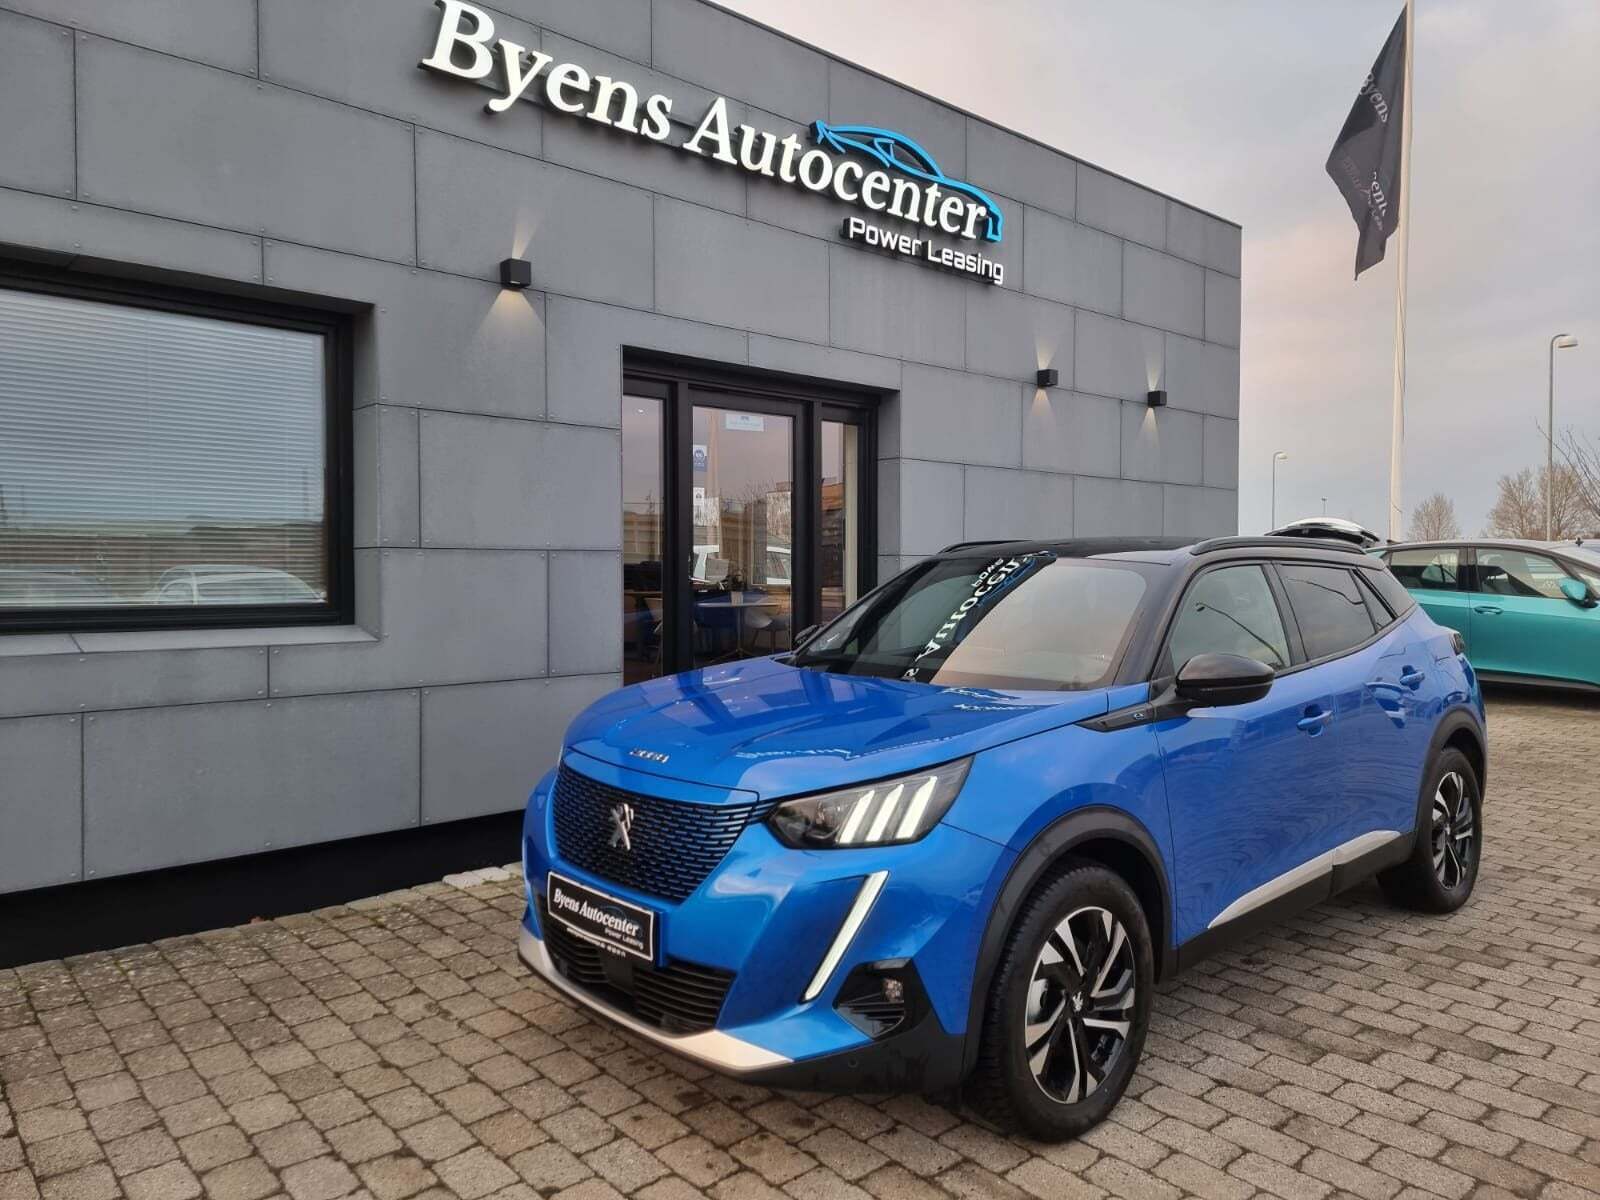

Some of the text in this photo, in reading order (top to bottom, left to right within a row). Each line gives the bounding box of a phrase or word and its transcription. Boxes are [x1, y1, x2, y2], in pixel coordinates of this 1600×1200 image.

[422, 0, 986, 240] Byens Autocenter
[848, 217, 1004, 284] Power Leasing
[554, 888, 639, 936] Byens Autocenter
